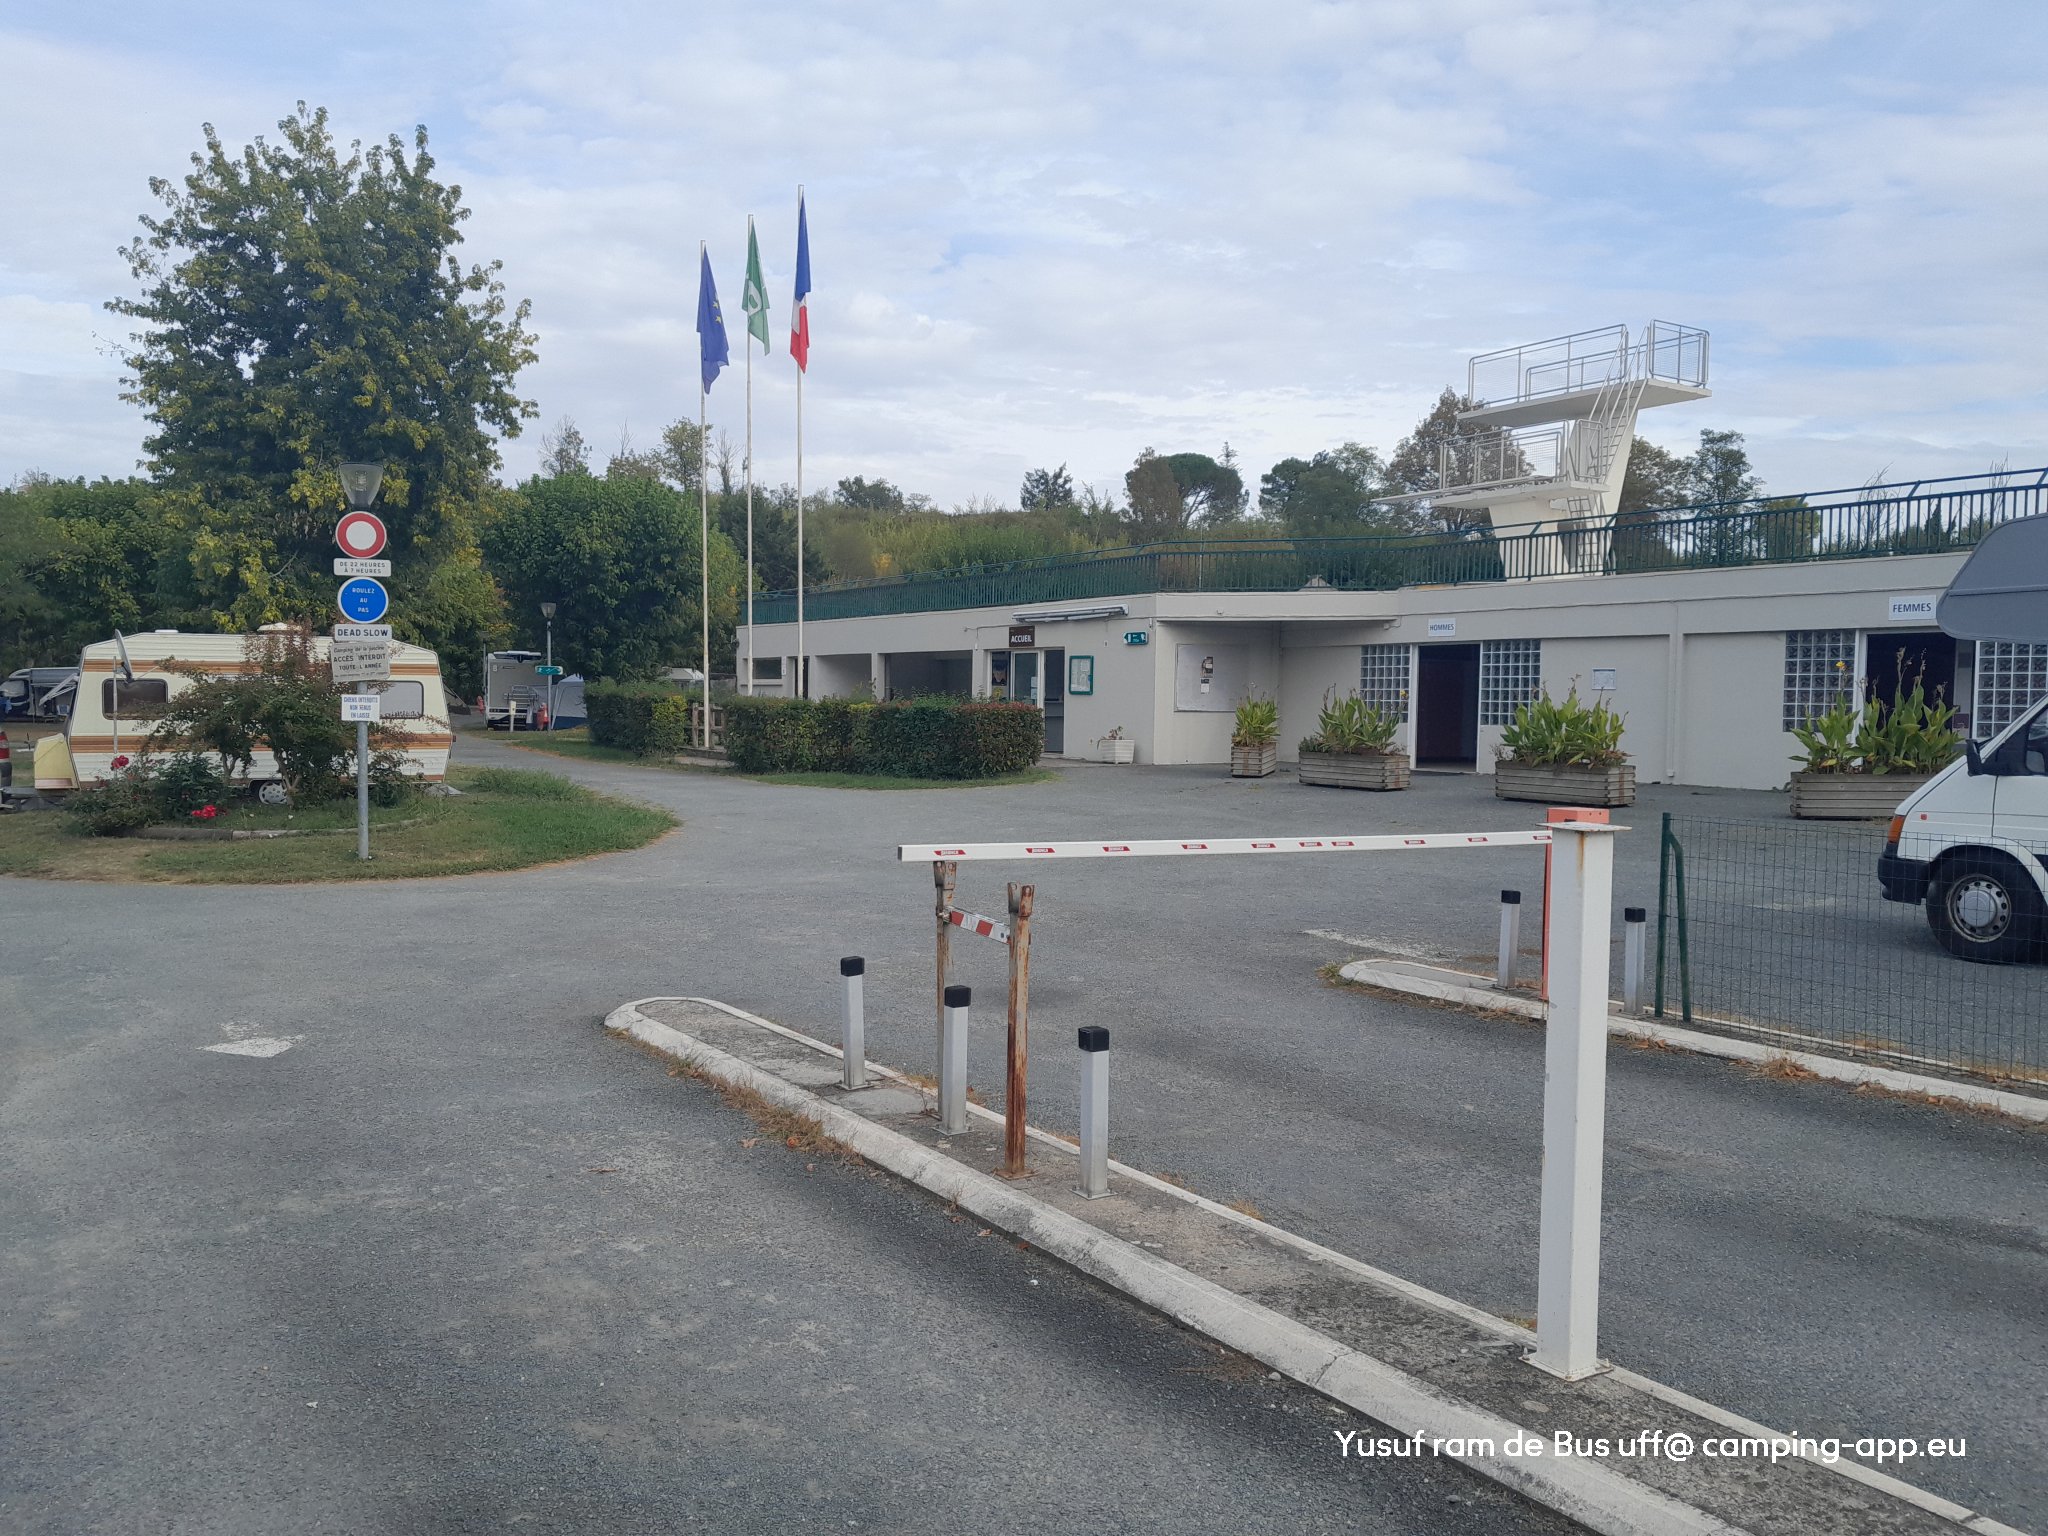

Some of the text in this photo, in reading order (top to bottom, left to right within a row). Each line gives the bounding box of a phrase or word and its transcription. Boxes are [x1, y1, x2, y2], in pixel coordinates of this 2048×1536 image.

[1892, 602, 1932, 613] FEMMES
[1429, 623, 1455, 631] HOMMES
[364, 629, 388, 637] SLOW
[1010, 634, 1033, 643] ACCUEIL
[358, 653, 386, 661] INTERDIT
